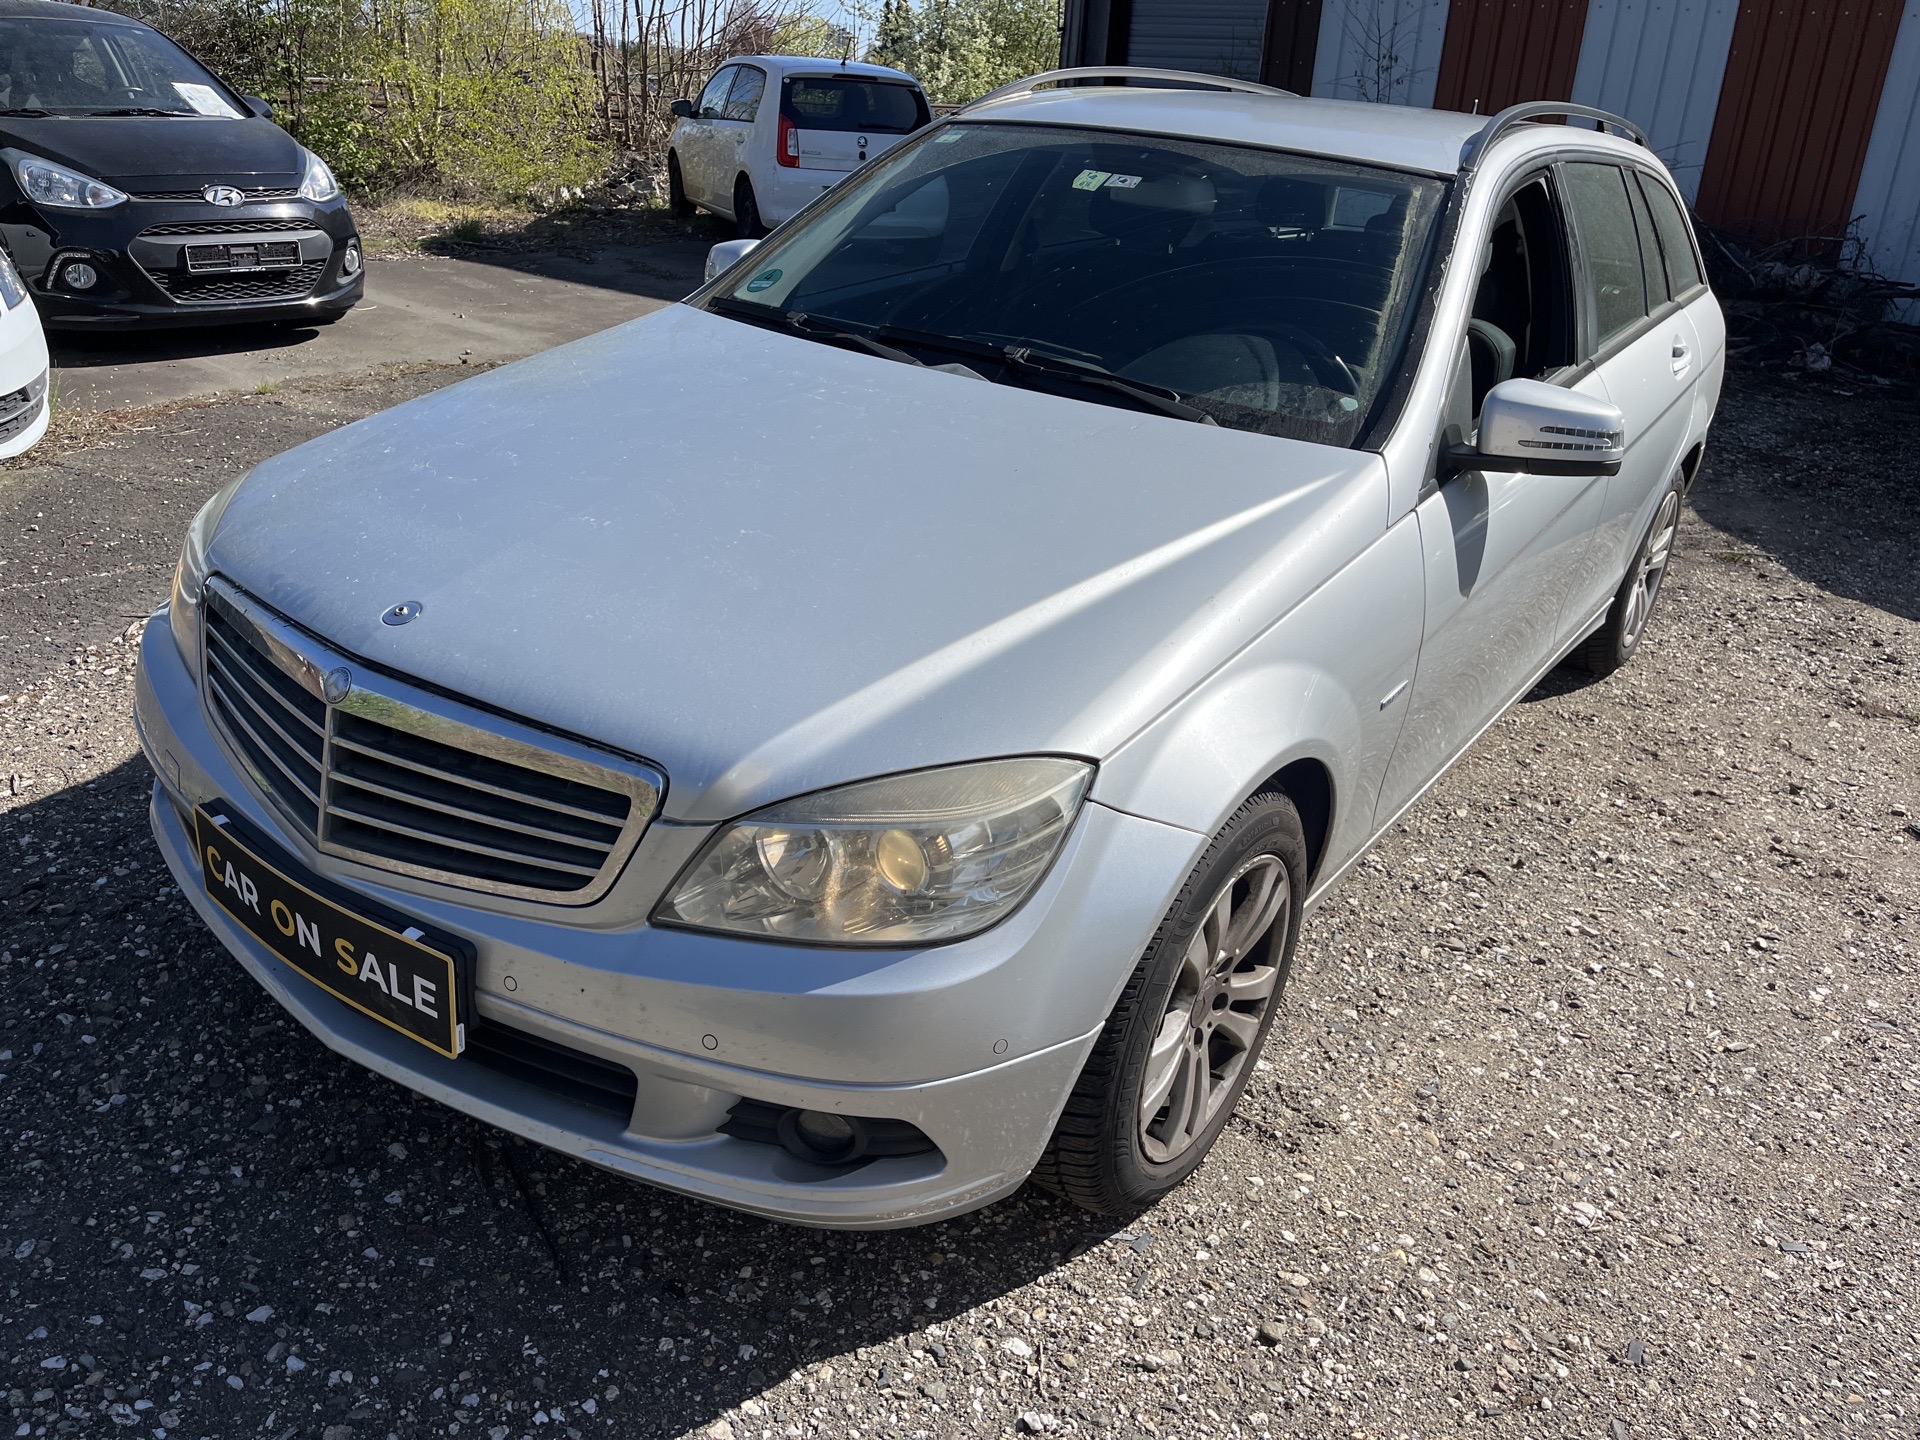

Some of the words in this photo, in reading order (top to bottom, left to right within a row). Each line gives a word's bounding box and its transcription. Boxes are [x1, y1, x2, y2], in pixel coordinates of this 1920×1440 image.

[206, 845, 262, 916] CAR
[270, 899, 322, 958] ON
[334, 937, 438, 1019] SALE
